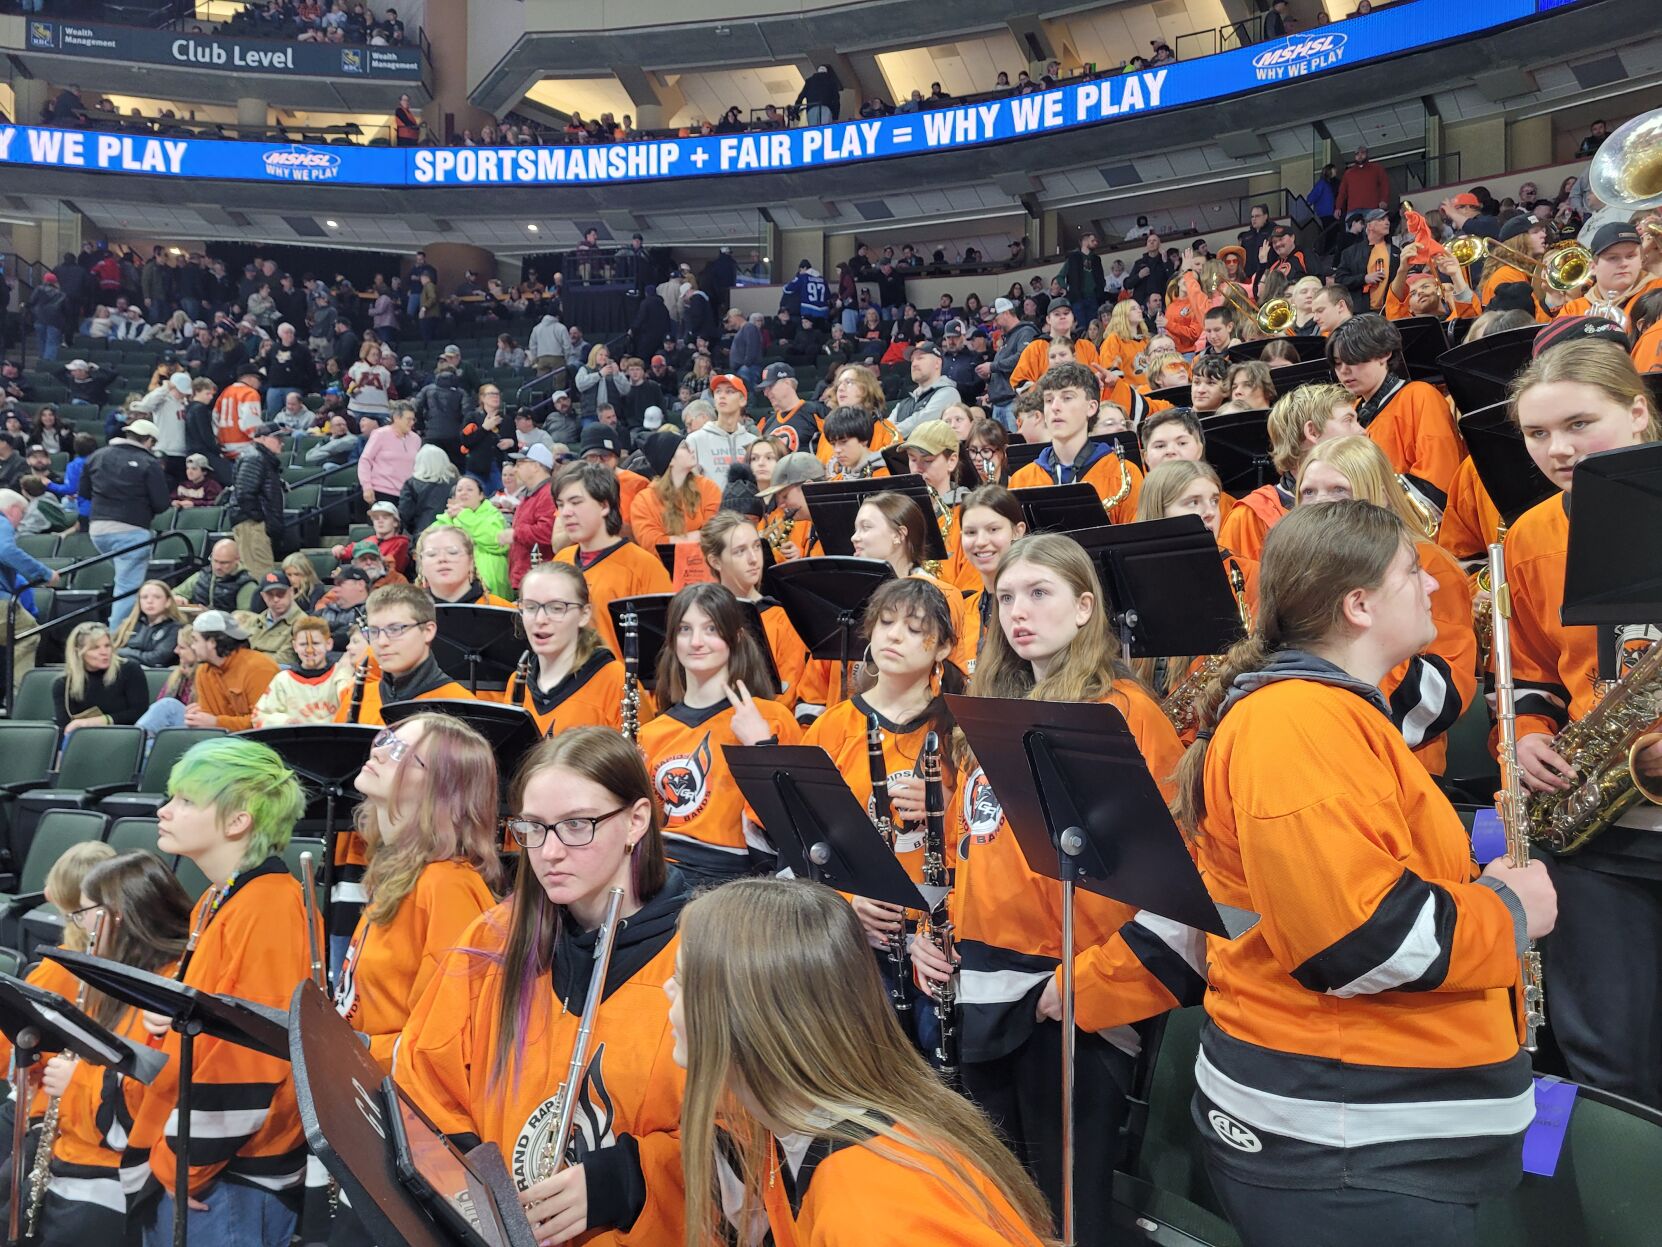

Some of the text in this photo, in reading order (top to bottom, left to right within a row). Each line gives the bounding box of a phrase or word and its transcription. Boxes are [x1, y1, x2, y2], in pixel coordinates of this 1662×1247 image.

[64, 27, 93, 37] Wealth
[64, 35, 116, 48] Management
[172, 39, 294, 68] Club Level
[371, 51, 398, 60] Wealth
[371, 60, 418, 71] Management
[1256, 46, 1345, 80] WHY WE PLAY
[1257, 35, 1334, 67] MSHSL
[414, 69, 1168, 183] SPORTSMANSHIP + FAIR PLAY = WHY WE PLAY
[28, 129, 85, 166] WE
[97, 135, 188, 173] PLAY
[267, 151, 331, 167] MSHSL
[265, 164, 338, 181] WHY WE PLAY
[807, 282, 826, 302] 97
[220, 397, 234, 428] 11
[683, 790, 711, 822] BANDS
[513, 1134, 530, 1193] RAND
